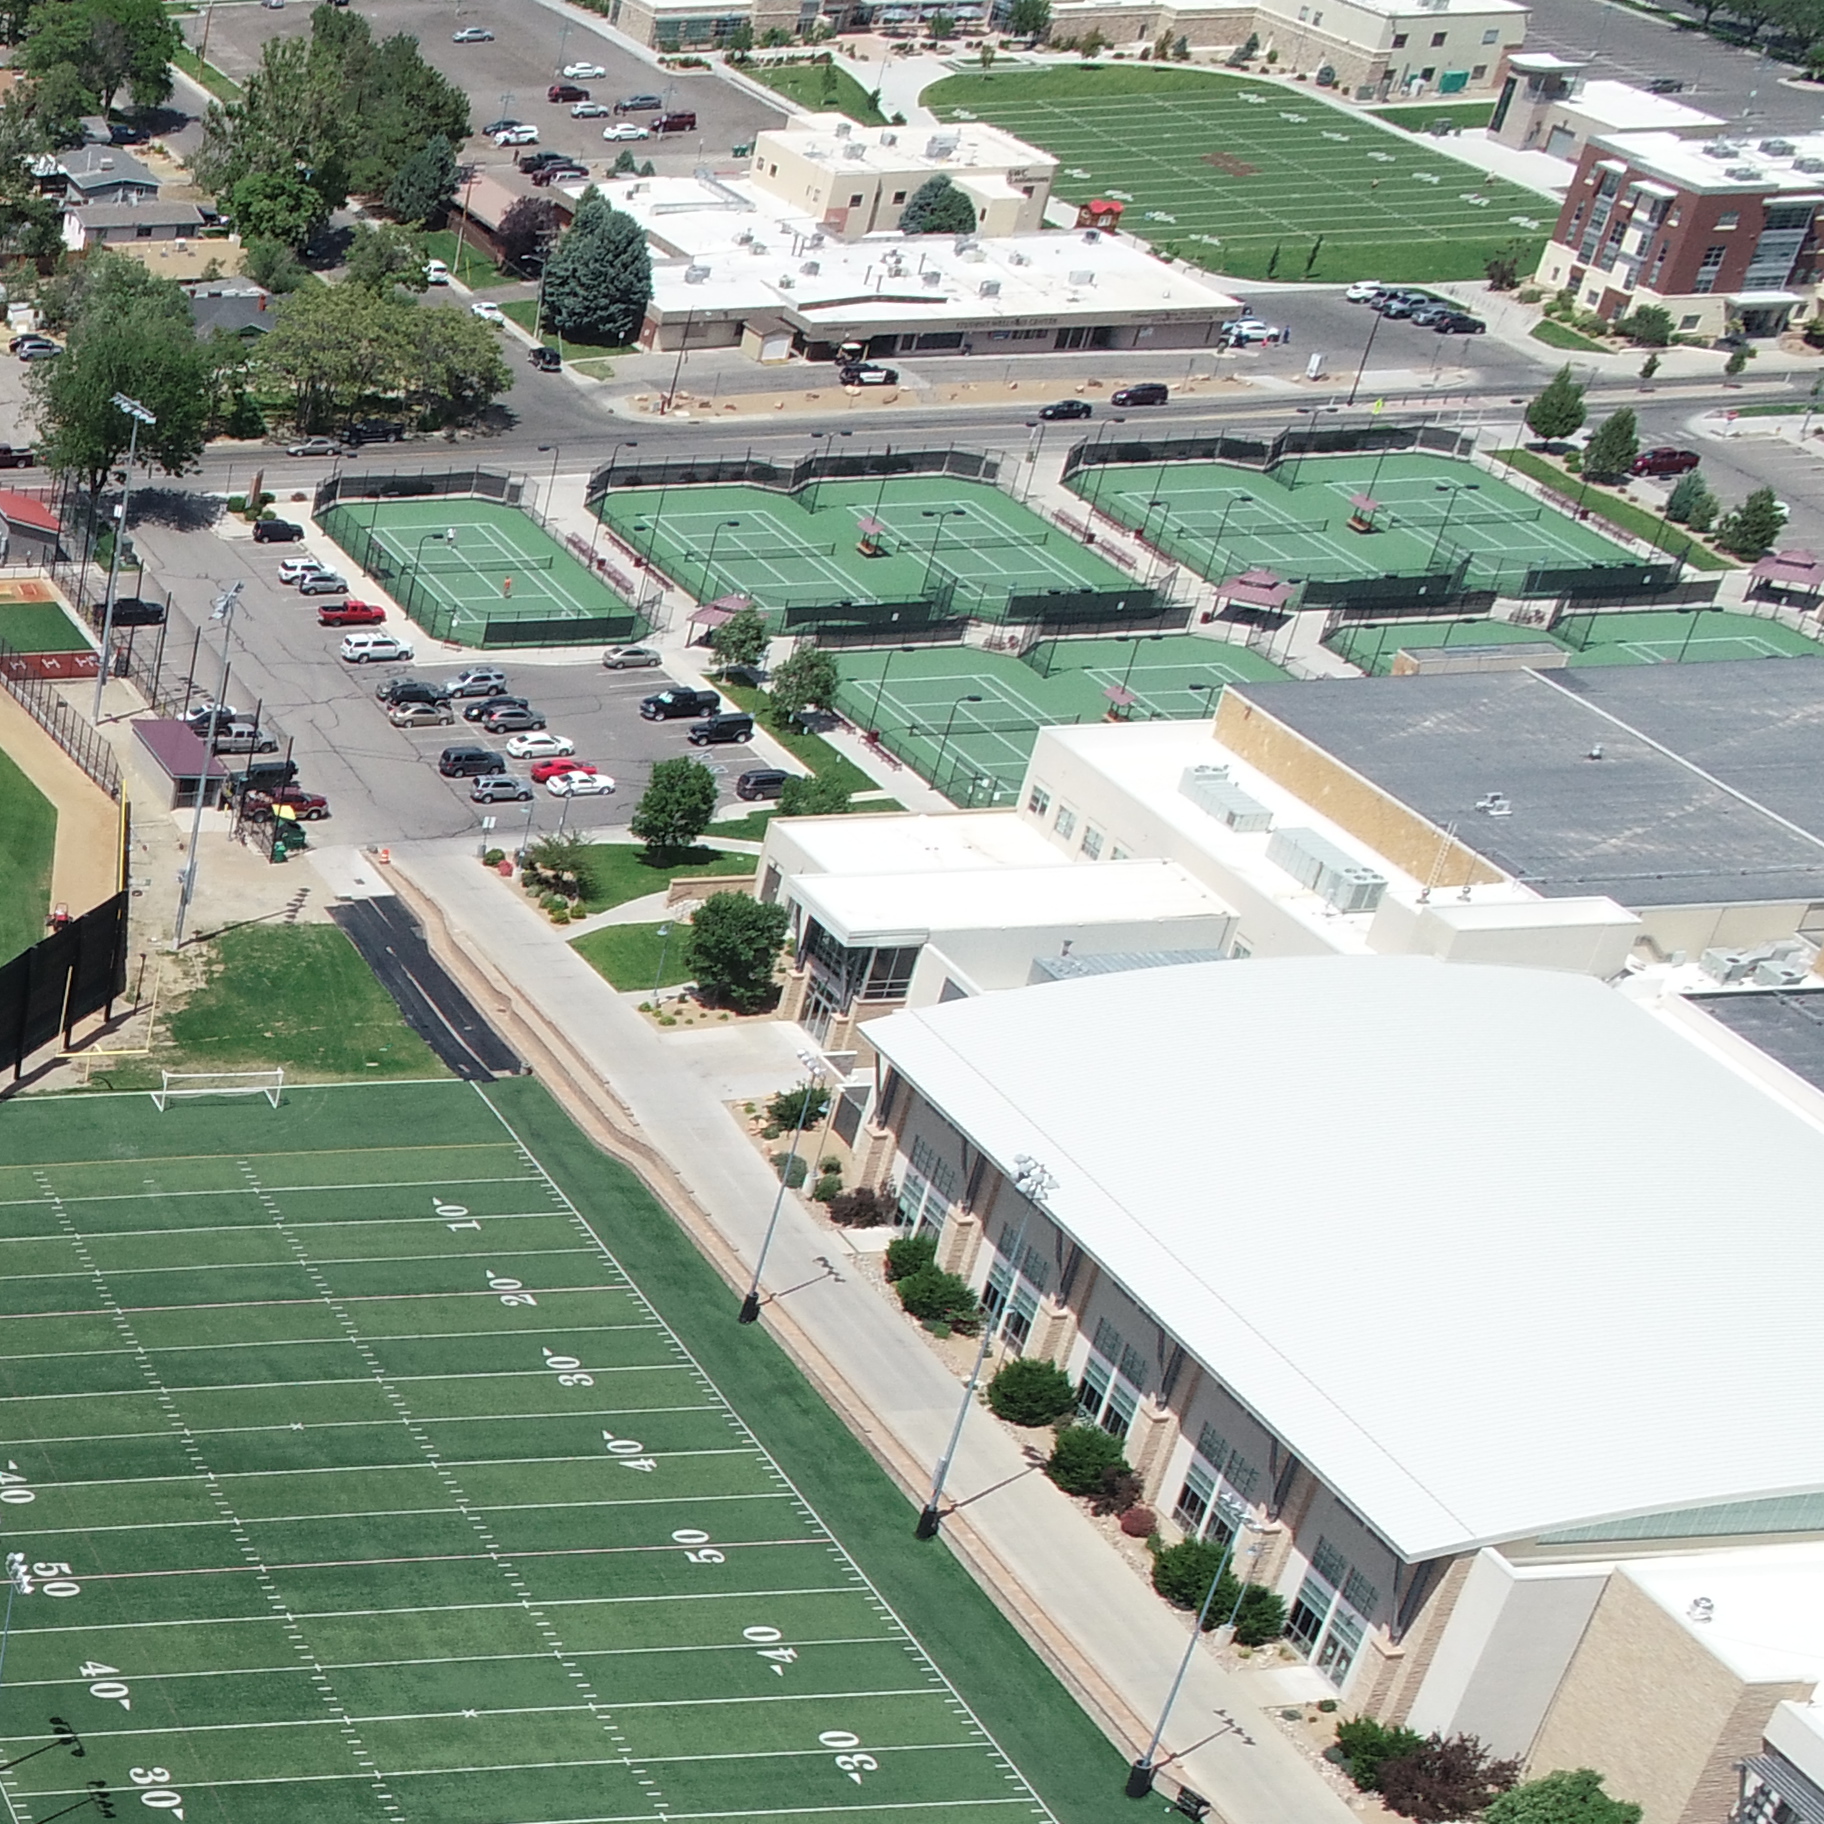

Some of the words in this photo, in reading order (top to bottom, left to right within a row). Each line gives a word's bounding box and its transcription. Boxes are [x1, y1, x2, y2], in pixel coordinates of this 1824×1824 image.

[435, 1205, 482, 1232] 10
[489, 1278, 537, 1306] 20
[545, 1356, 594, 1386] 30
[607, 1439, 657, 1472] 40
[672, 1529, 725, 1563] 50
[32, 1562, 81, 1597] 50
[742, 1626, 798, 1663] 40
[78, 1661, 129, 1698] 40
[818, 1731, 878, 1770] 30
[129, 1767, 182, 1808] 30
